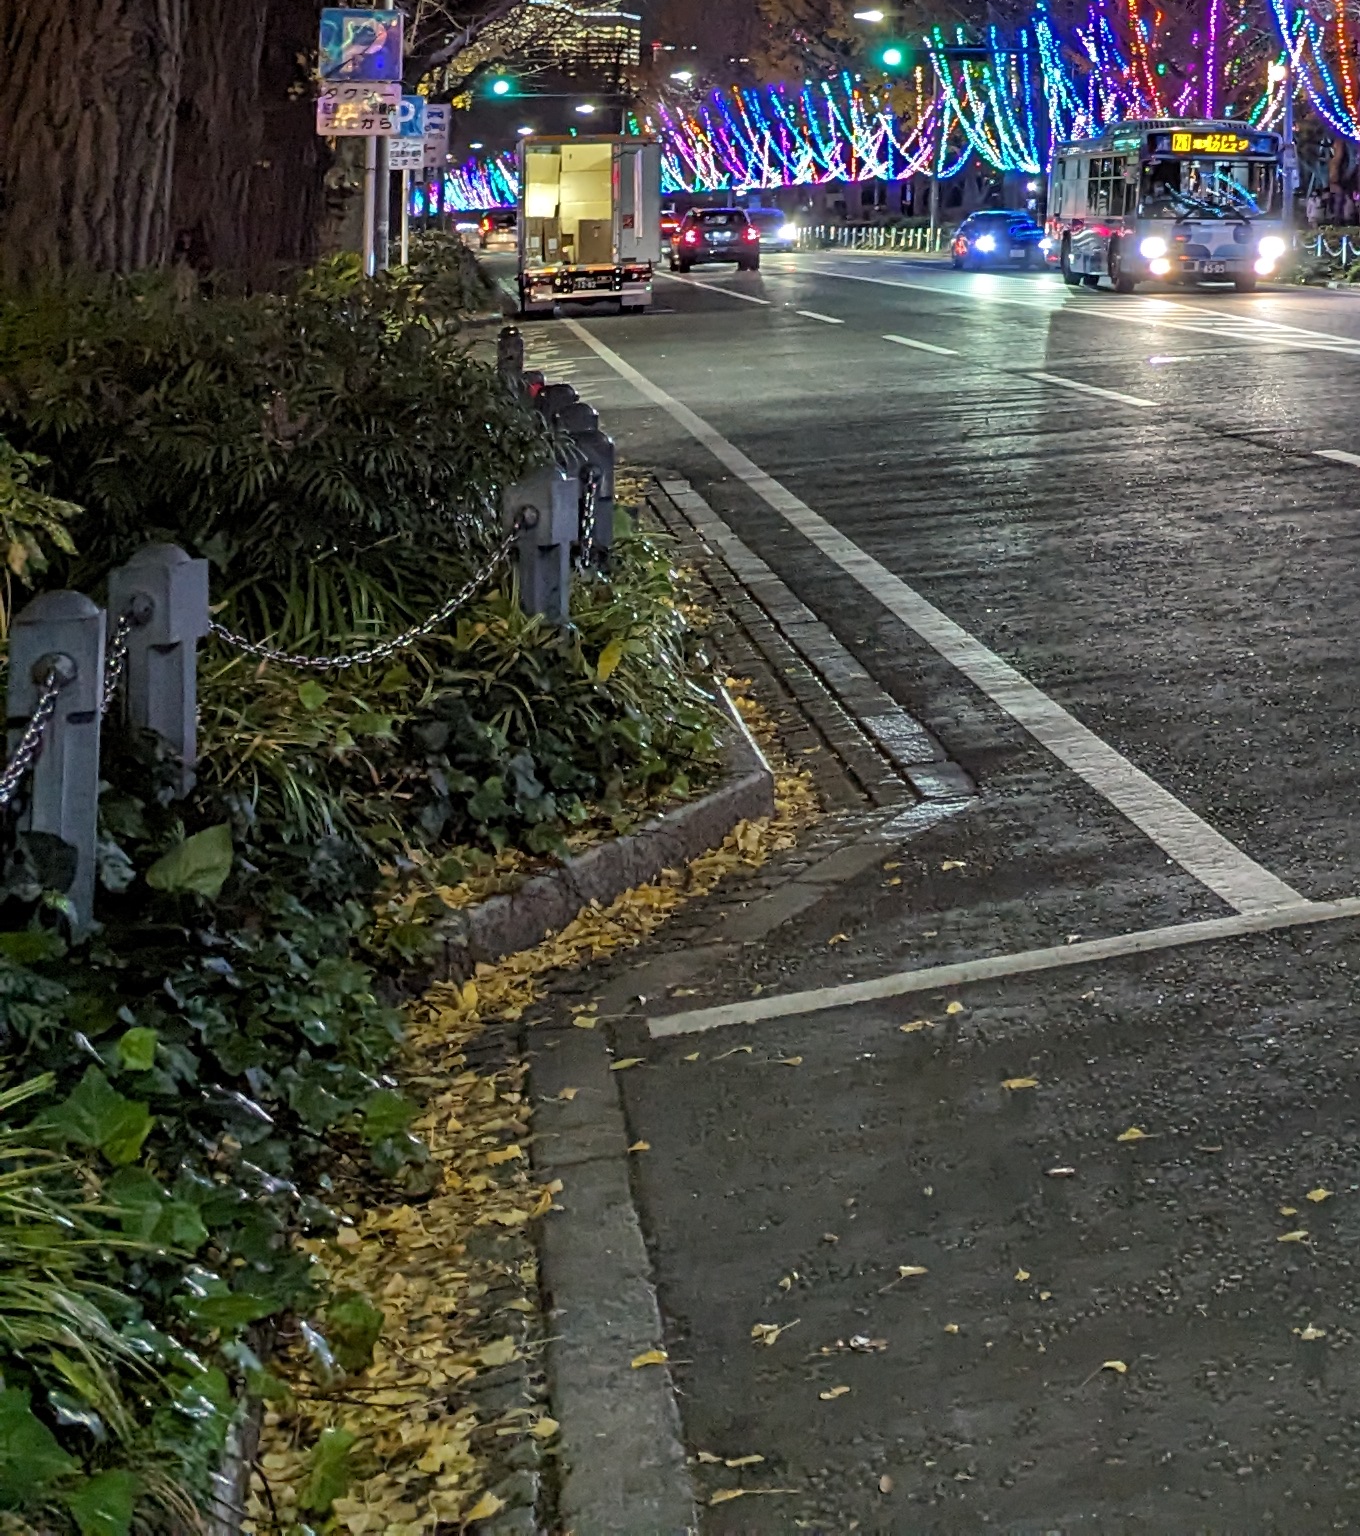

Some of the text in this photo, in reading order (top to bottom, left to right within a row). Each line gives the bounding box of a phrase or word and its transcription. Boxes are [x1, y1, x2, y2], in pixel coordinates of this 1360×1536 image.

[342, 16, 387, 73] P
[325, 88, 395, 99] タクシー
